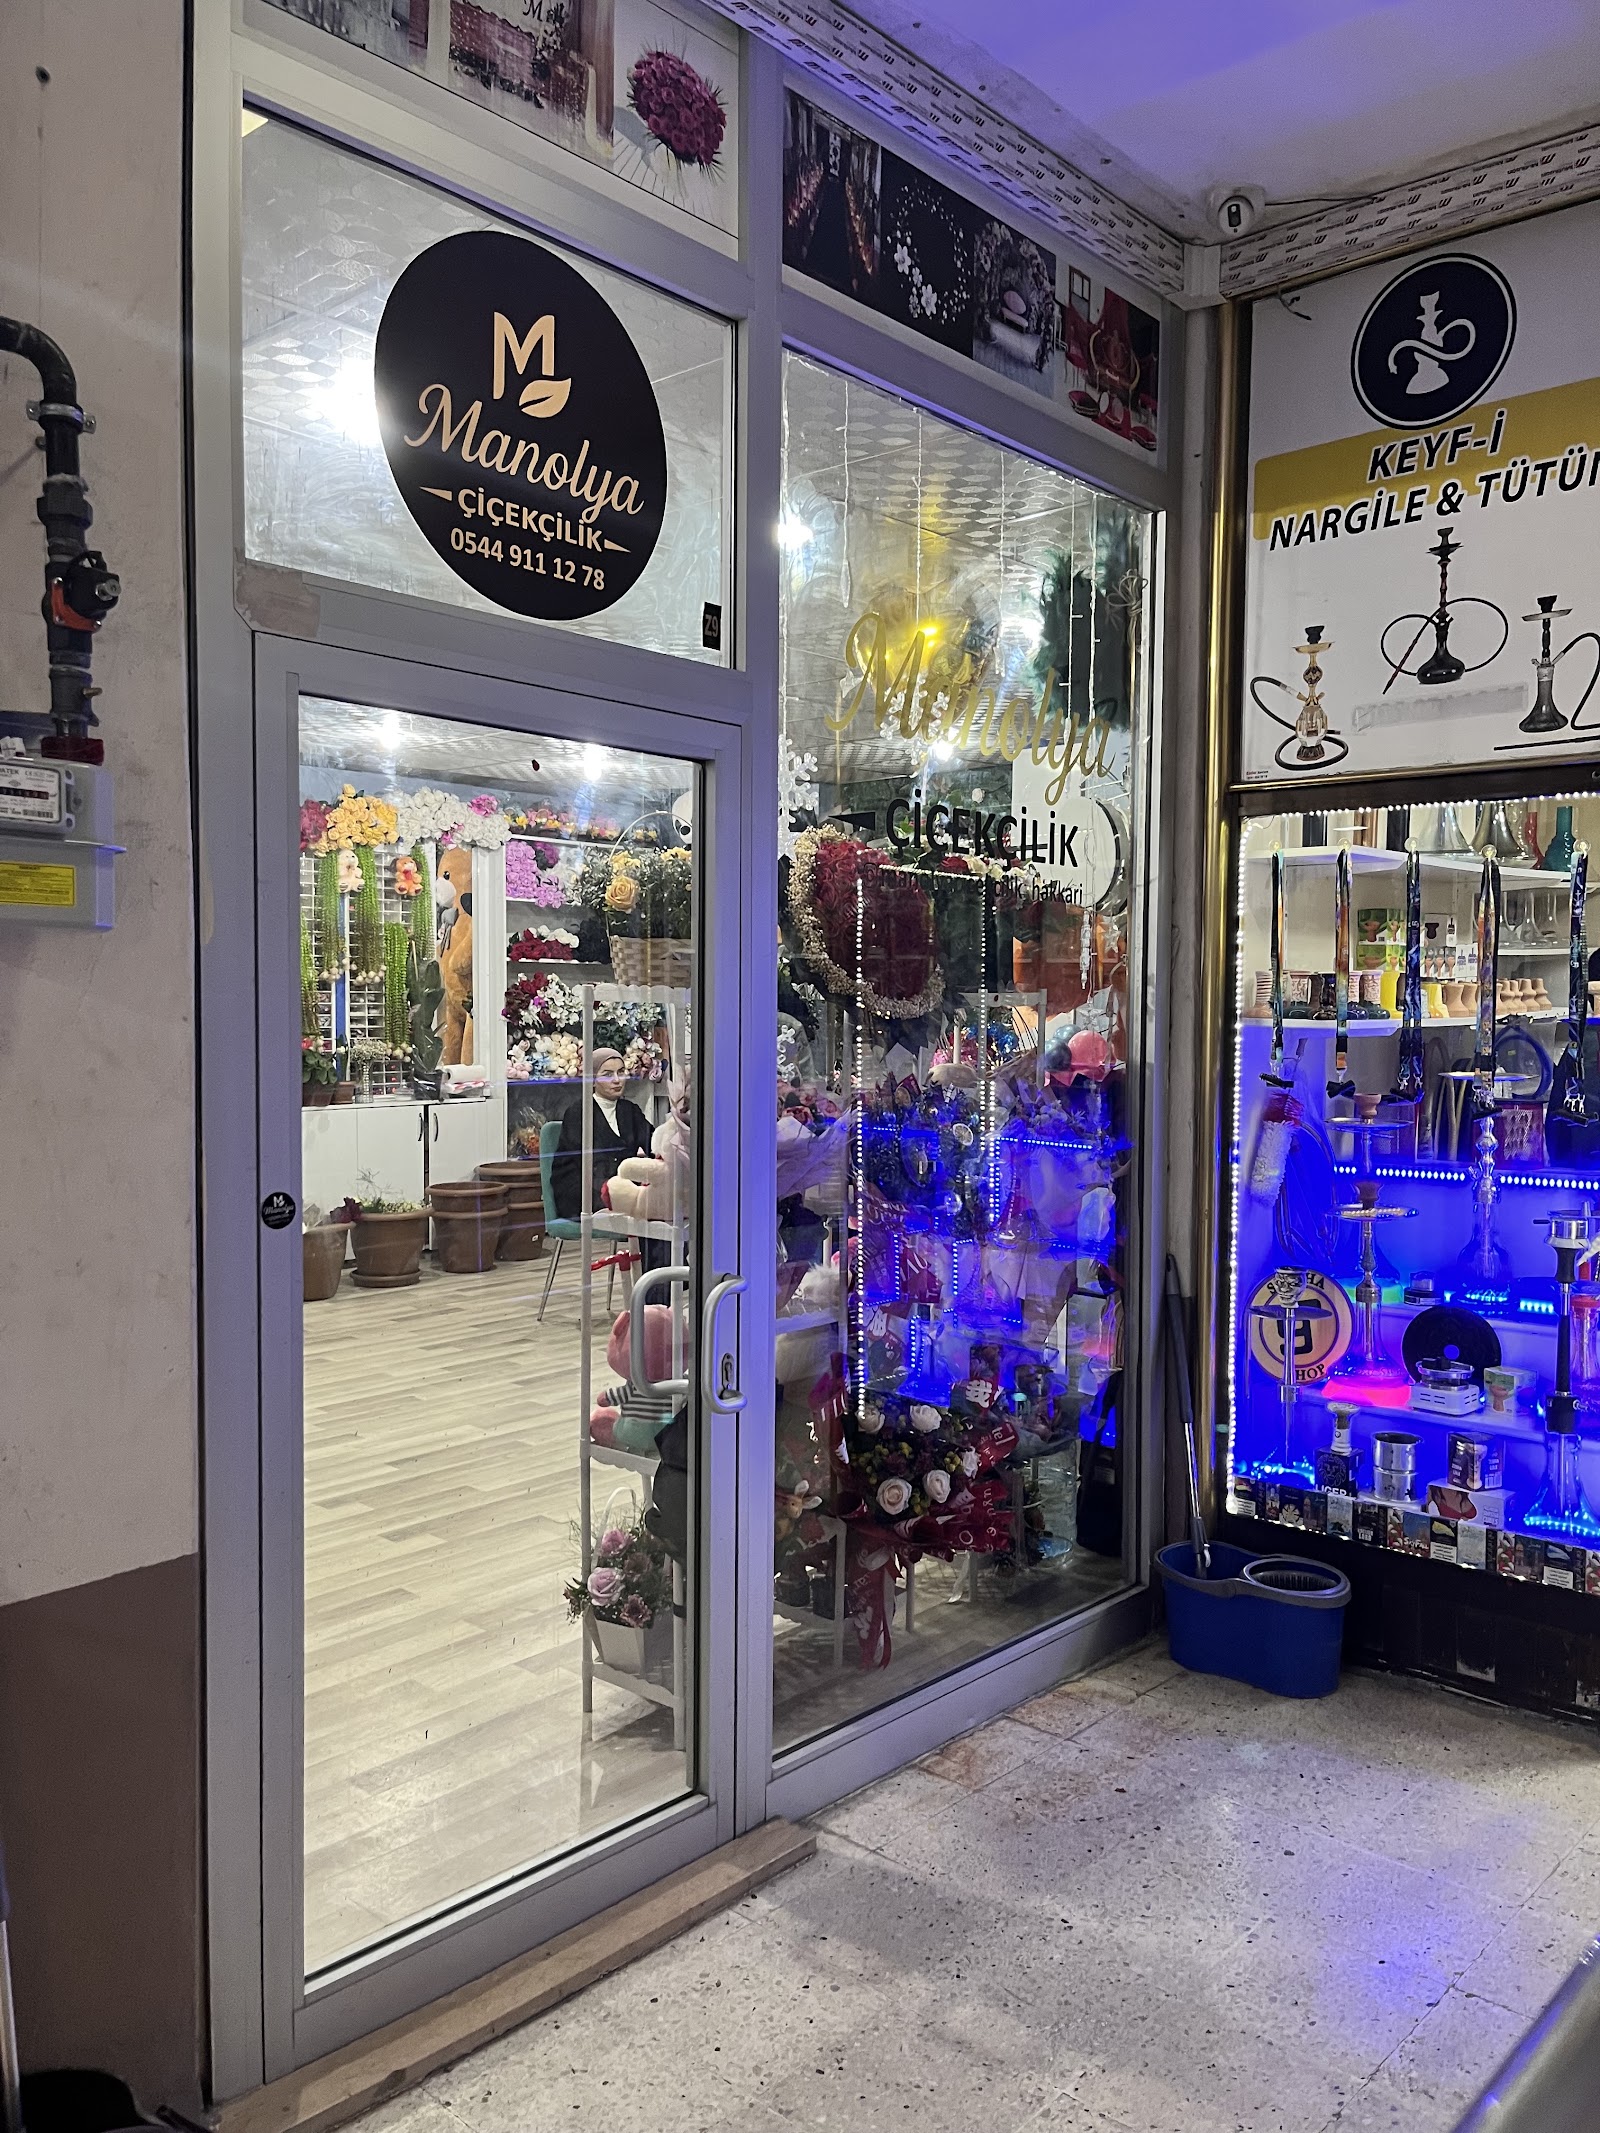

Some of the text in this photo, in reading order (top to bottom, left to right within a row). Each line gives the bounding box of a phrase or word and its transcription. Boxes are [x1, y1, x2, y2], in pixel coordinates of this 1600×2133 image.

[404, 383, 645, 524] Manolya
[1367, 409, 1505, 482] KEYF-İ
[457, 487, 603, 553] ÇİÇEKÇİLİK
[1269, 489, 1428, 551] NARGİLE
[1436, 481, 1465, 517] &
[450, 527, 605, 591] 0544 911 12 78
[824, 611, 1116, 806] Manolya
[886, 789, 1079, 872] ÇİÇEKÇİLİK
